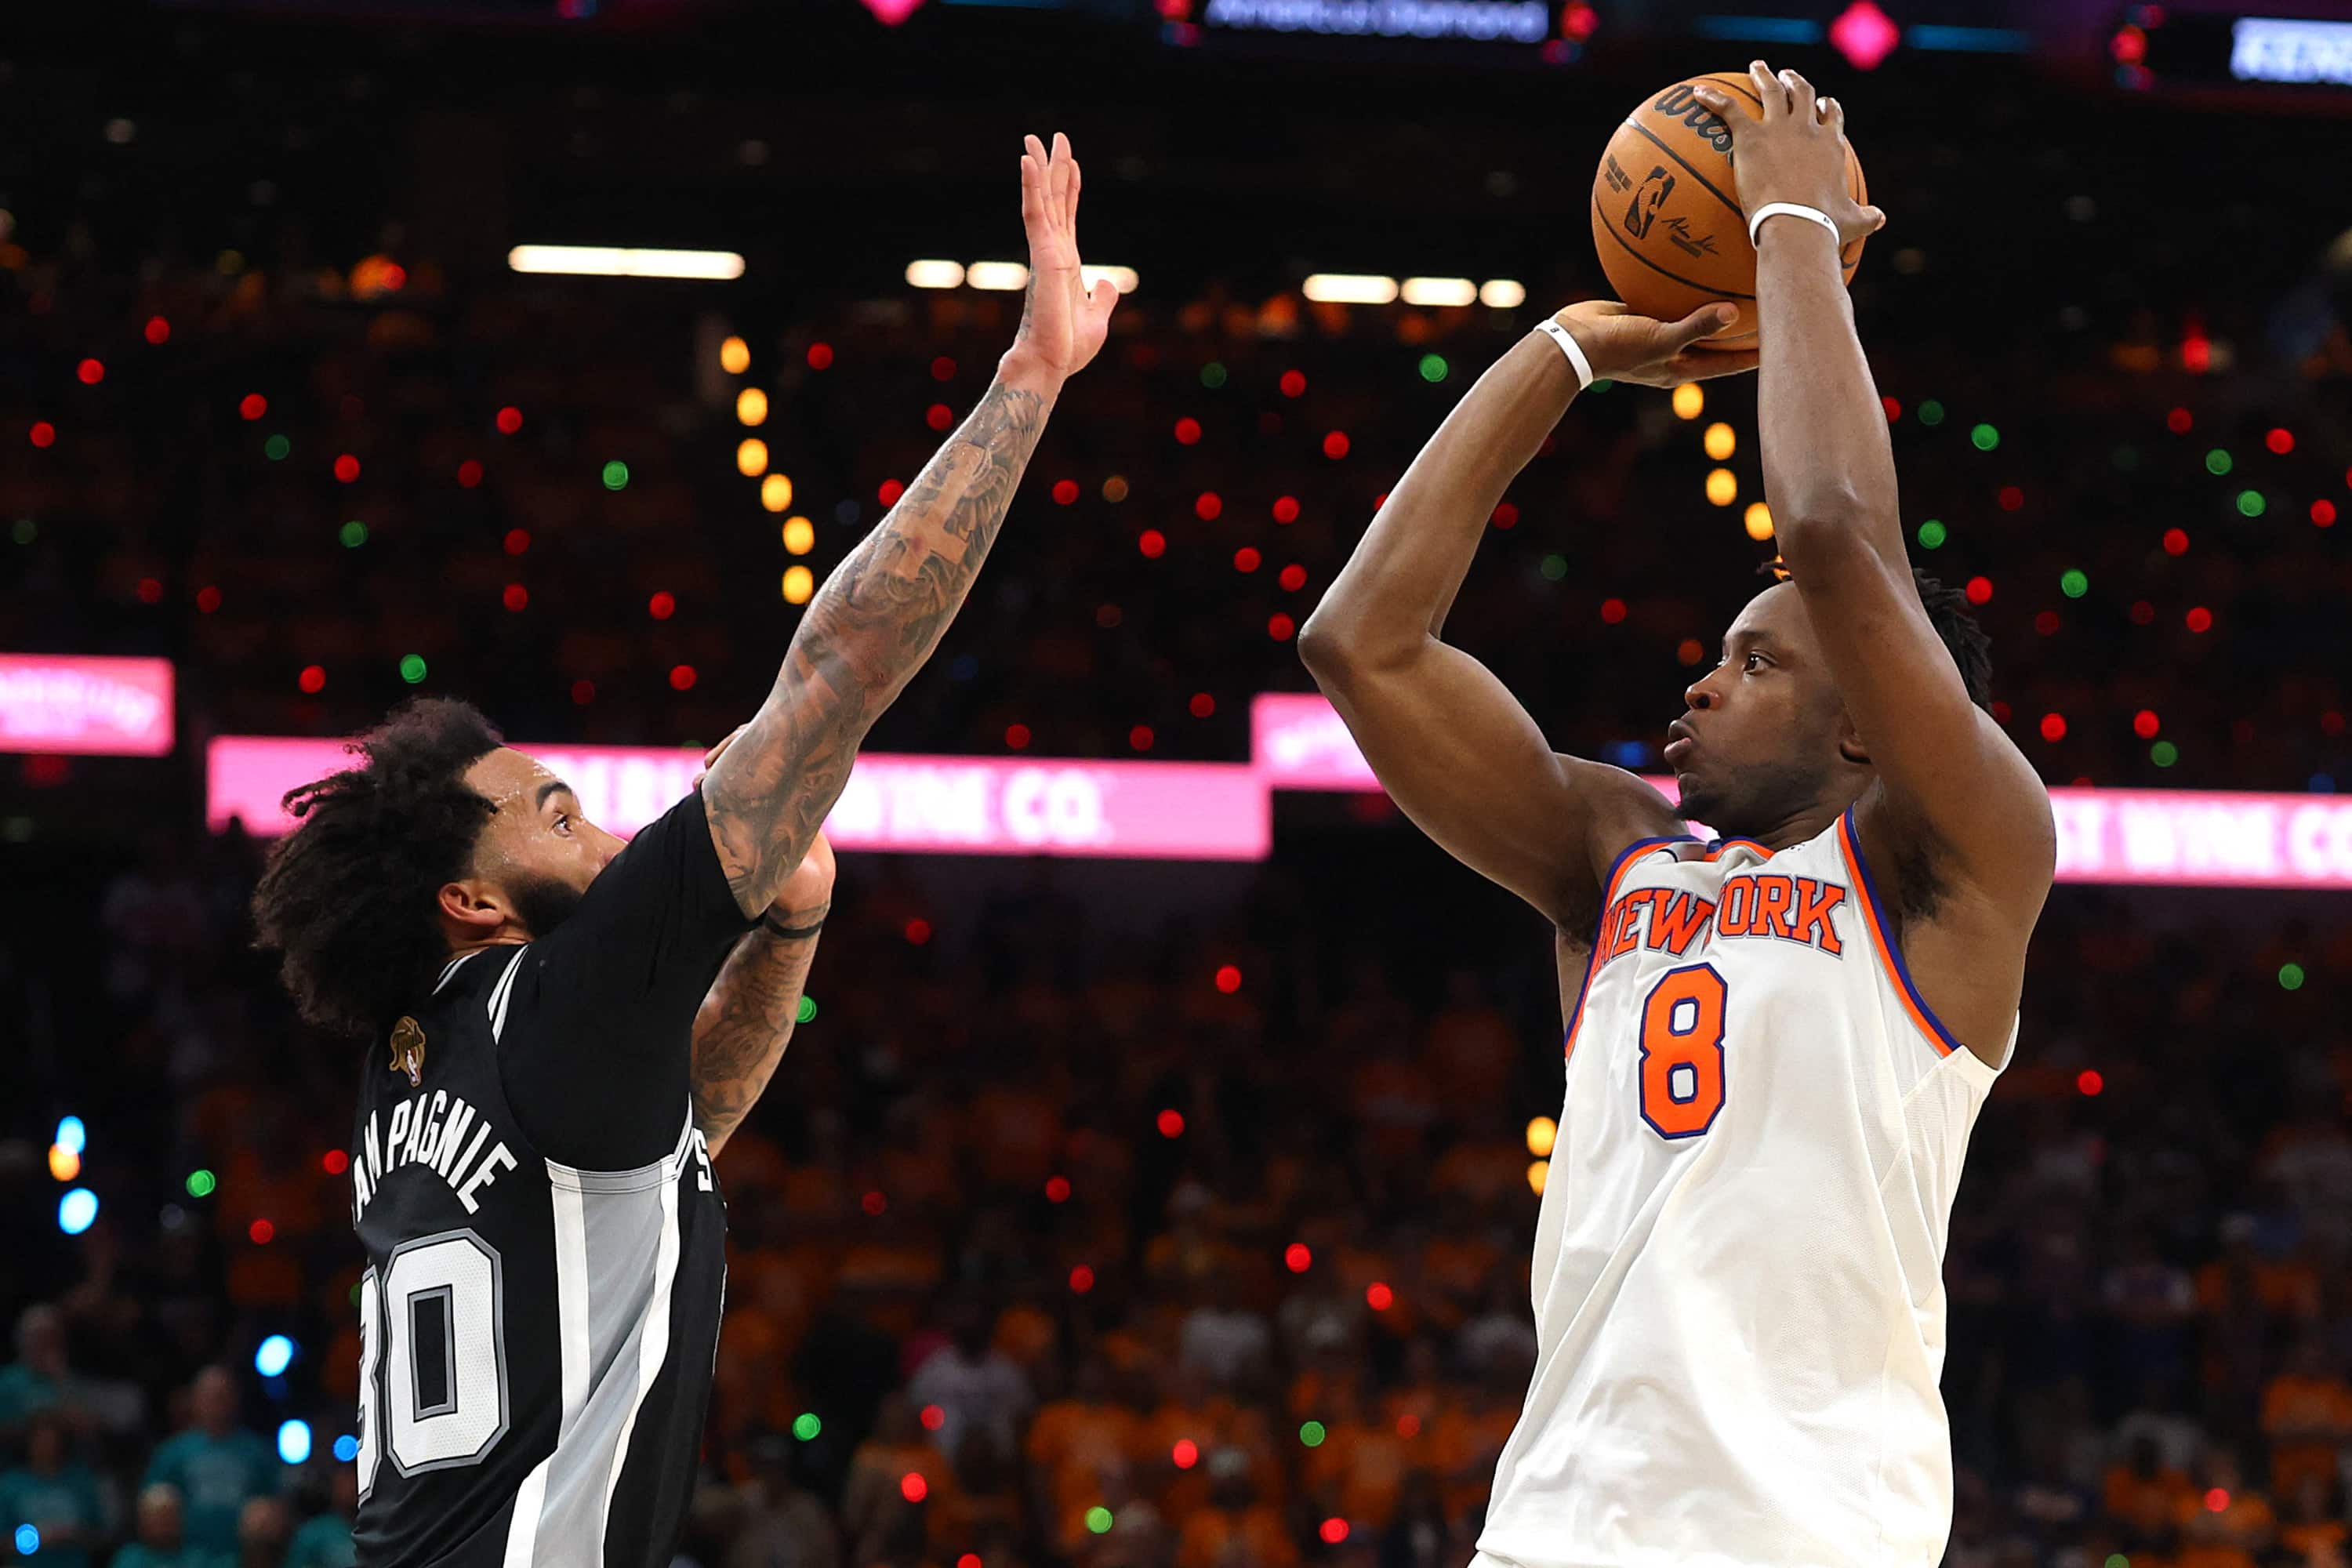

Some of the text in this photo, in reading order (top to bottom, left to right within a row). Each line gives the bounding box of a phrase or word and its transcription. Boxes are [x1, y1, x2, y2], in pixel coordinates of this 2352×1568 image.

[1653, 84, 1734, 167] Wils
[1599, 874, 1846, 966] NEW ORK
[1639, 962, 1727, 1140] 8
[352, 1088, 518, 1228] AMPAGNIE
